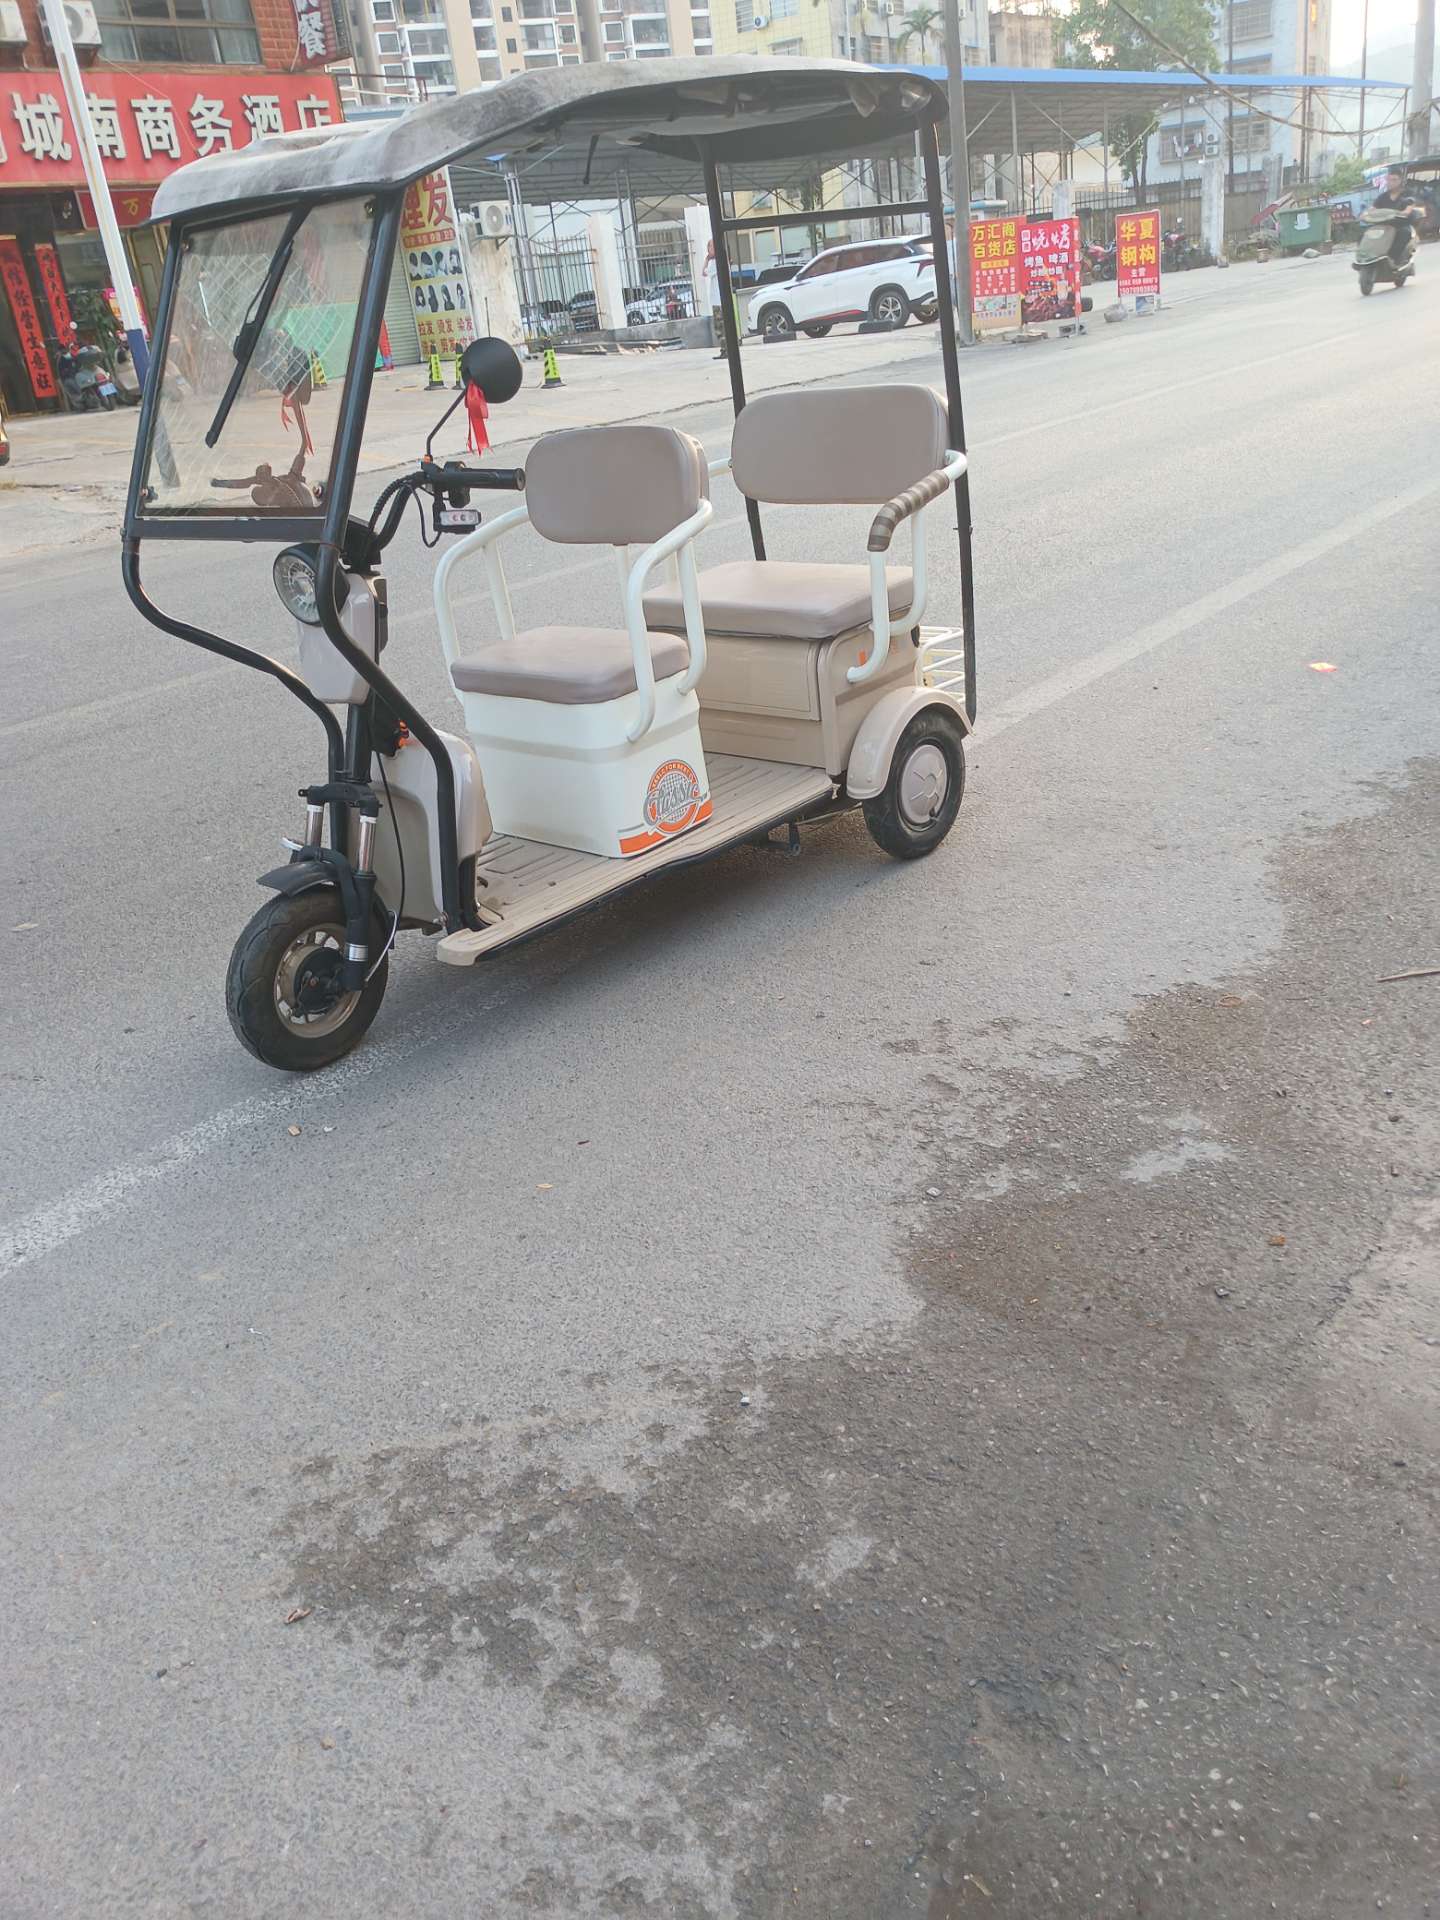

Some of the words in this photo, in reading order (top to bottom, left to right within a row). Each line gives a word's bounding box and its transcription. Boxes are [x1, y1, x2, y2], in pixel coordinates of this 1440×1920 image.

[0, 94, 332, 162] 城南商务酒店
[402, 173, 454, 230] 理发
[973, 222, 1016, 242] 万汇阁
[1032, 223, 1070, 252] 烧烤
[1120, 217, 1155, 241] 华夏
[974, 240, 1016, 258] 百货店
[1024, 255, 1043, 268] 烤鱼
[1048, 252, 1068, 265] 啤酒
[1121, 243, 1156, 266] 钢构
